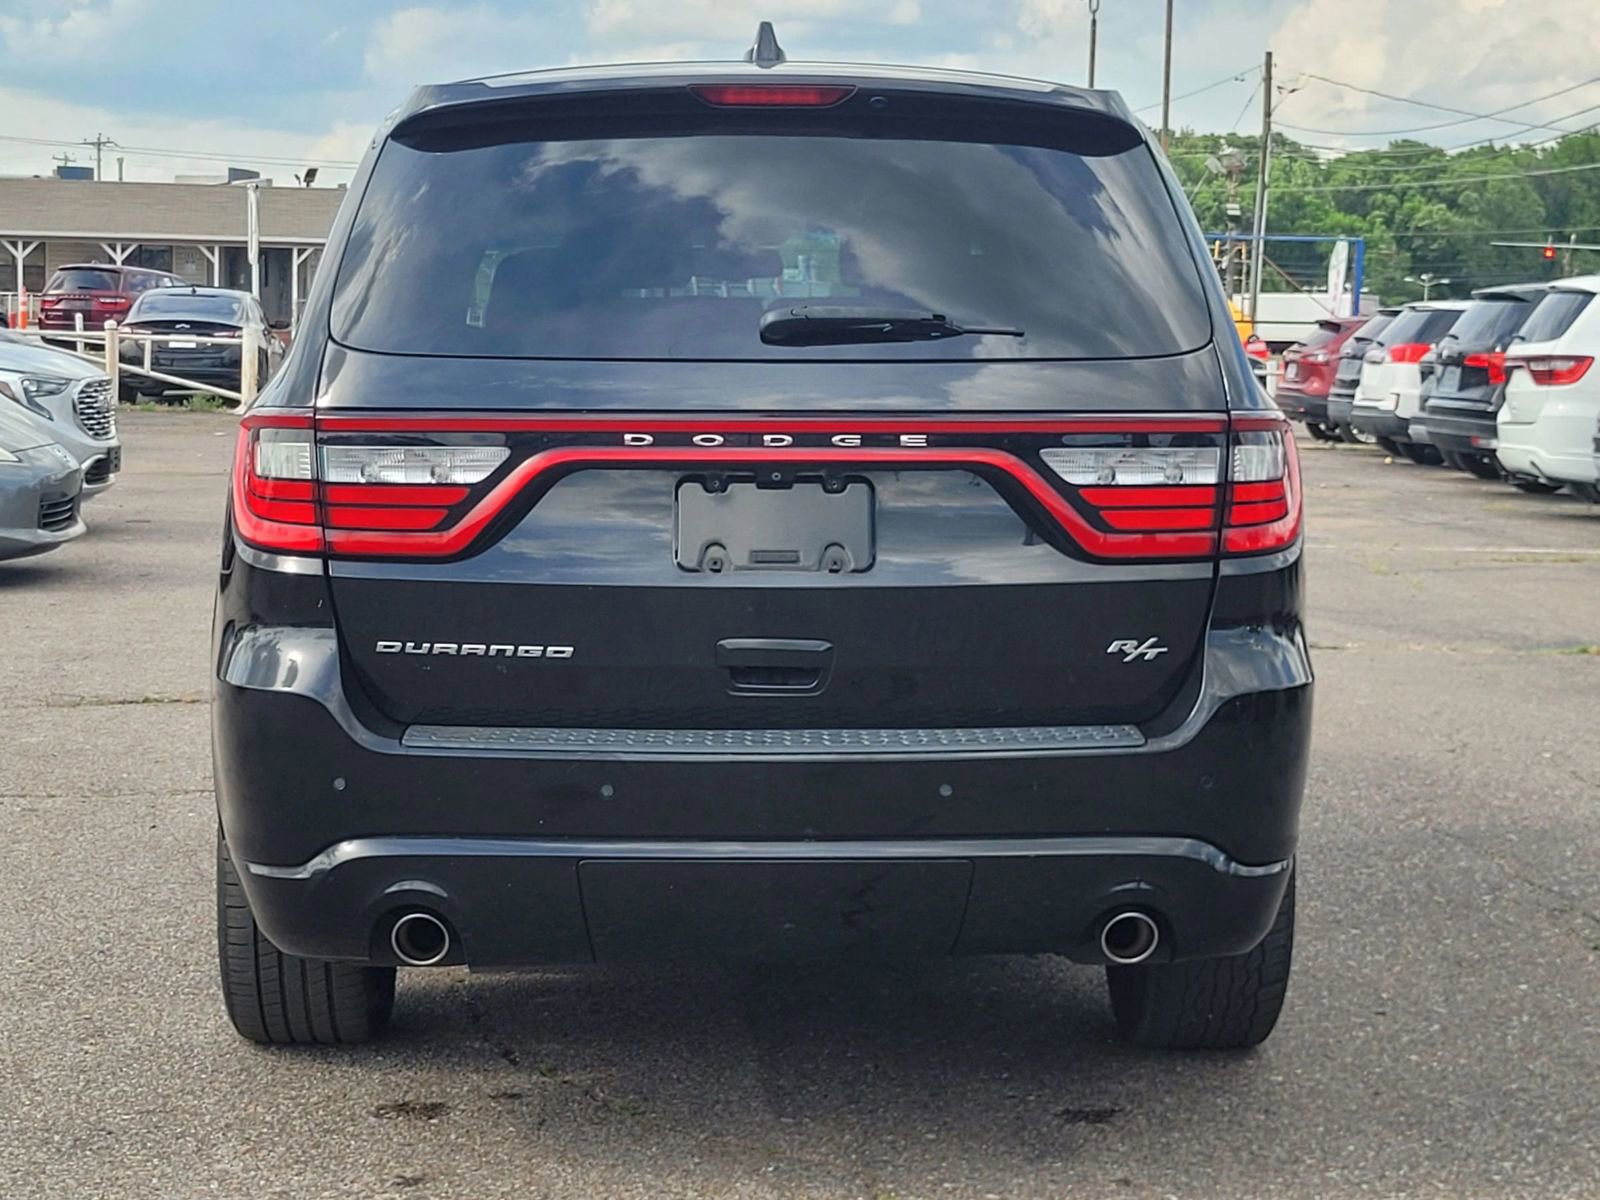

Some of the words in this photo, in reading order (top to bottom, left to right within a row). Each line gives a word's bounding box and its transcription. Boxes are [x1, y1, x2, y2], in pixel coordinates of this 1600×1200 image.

[623, 433, 928, 447] DODGE
[375, 640, 575, 659] DURANGO
[1106, 636, 1169, 663] R/T
